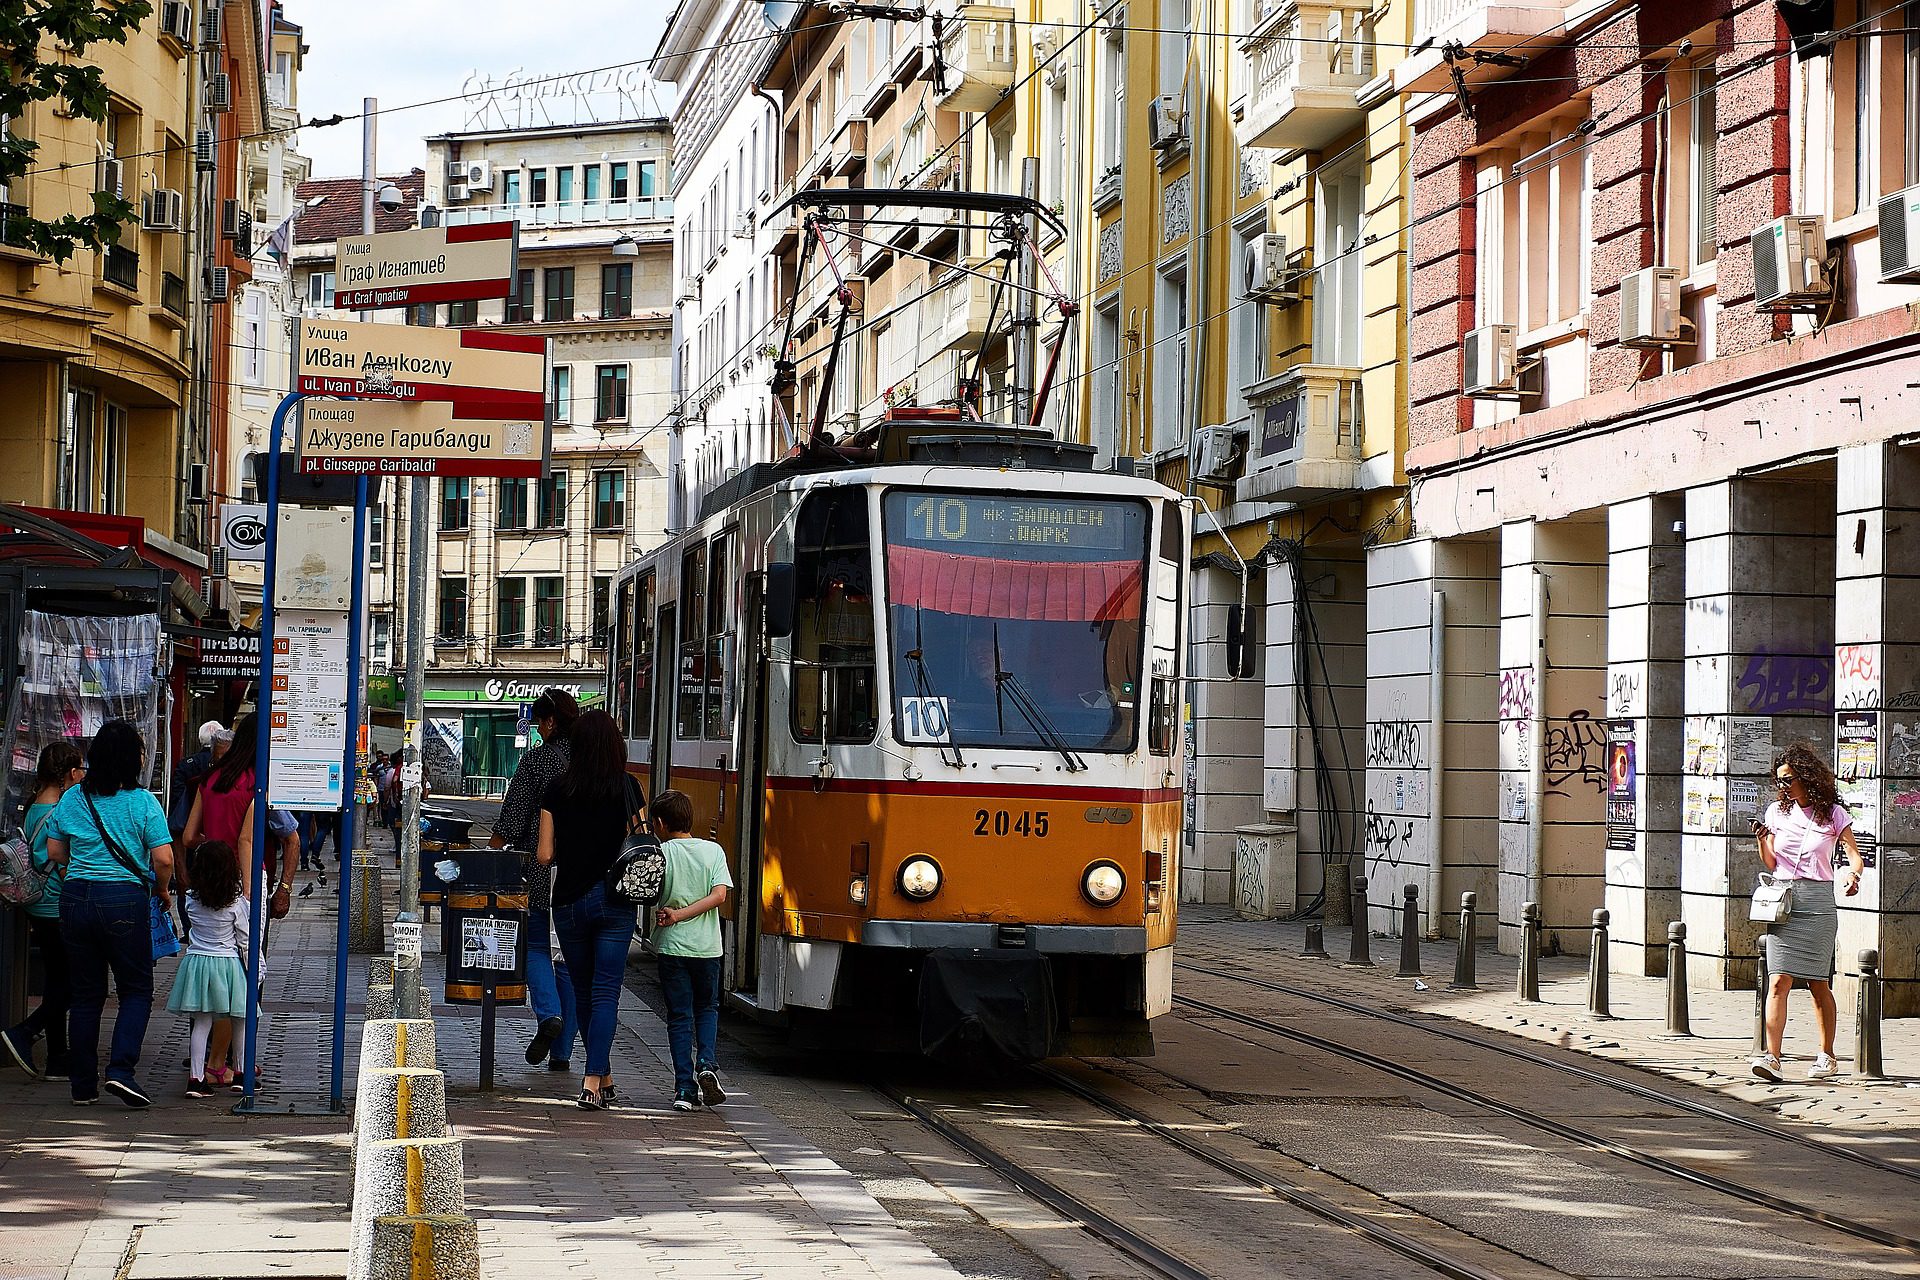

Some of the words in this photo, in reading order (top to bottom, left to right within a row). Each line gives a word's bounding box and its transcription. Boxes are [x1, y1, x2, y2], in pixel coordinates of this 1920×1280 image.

[345, 242, 371, 256] Улица
[343, 261, 375, 286] Граф
[378, 254, 446, 279] Игнатиев
[342, 293, 353, 305] ul.
[354, 290, 373, 305] Graf
[374, 288, 409, 306] Ignatiev
[307, 325, 348, 342] Улица
[304, 347, 355, 369] Иван
[303, 378, 320, 391] ul.
[324, 379, 351, 393] Ivan
[308, 407, 355, 423] Площад
[307, 428, 385, 450] Джузепе
[390, 427, 491, 451] Гарибалди
[306, 459, 320, 473] pl.
[323, 458, 376, 474] Giuseppe
[379, 458, 436, 472] Garibaldi
[913, 497, 968, 540] 10
[1010, 505, 1103, 526] ЗАПАДЕН
[202, 636, 262, 652] ПРЕВОД
[277, 641, 287, 650] 10
[201, 667, 237, 676] ВИЗИТКИ
[275, 678, 286, 687] 12
[274, 715, 285, 724] 18
[904, 700, 948, 737] 10
[974, 809, 1049, 838] 2045
